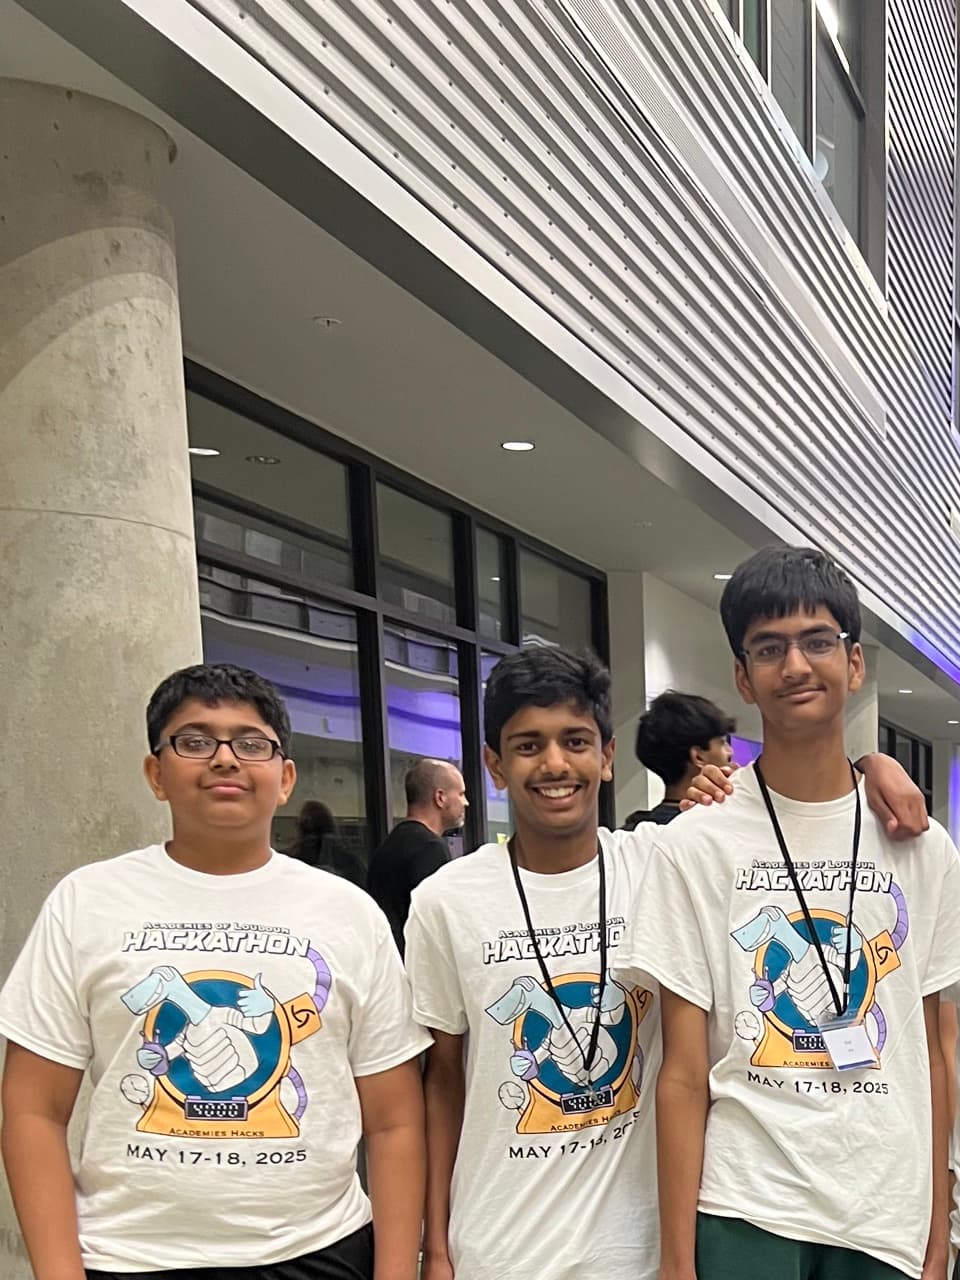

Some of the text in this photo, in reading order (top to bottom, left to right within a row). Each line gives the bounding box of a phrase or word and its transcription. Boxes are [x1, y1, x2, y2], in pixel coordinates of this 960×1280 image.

[751, 859, 876, 870] ACADEIES OF LOUOUN
[735, 868, 893, 893] HACKATHON
[143, 921, 291, 934] ACADEMIES OF LOUDOUN
[498, 917, 624, 939] ACADMIES OF LOUOUN
[122, 930, 311, 958] HACKATHON
[782, 1059, 831, 1067] ACADEMIES
[746, 1070, 889, 1095] MAY 17-18, 2025
[193, 1103, 239, 1117] 4000
[169, 1127, 265, 1138] ACADEMIES HACKS
[127, 1143, 307, 1167] MAY 17-18, 2025
[508, 1145, 551, 1159] MAY
